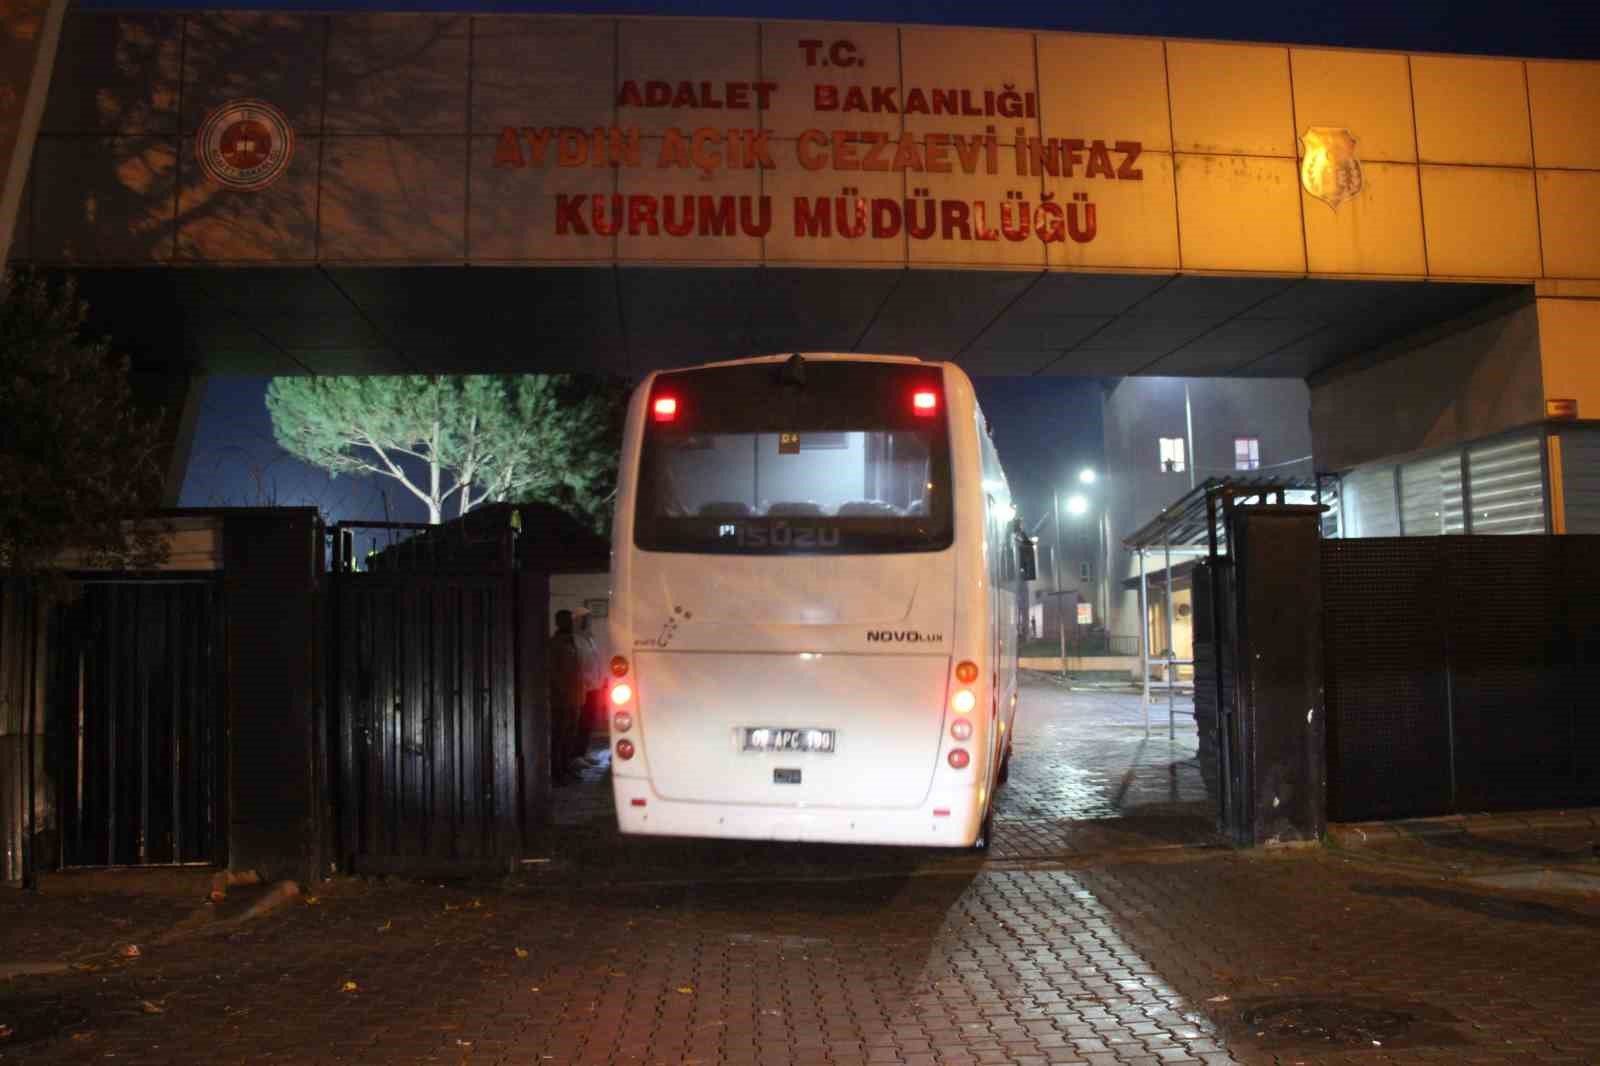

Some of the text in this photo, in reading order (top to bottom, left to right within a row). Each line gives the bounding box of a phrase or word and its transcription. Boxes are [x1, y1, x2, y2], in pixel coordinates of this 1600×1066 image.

[798, 39, 865, 67] T.C.
[616, 80, 1037, 118] ADALET BAKANLIĞI
[494, 126, 1144, 181] AYDIN AÇIK CEZAEVİ İNFAZ
[555, 187, 1098, 243] KURUMU MÜDÜRLÜĞÜ
